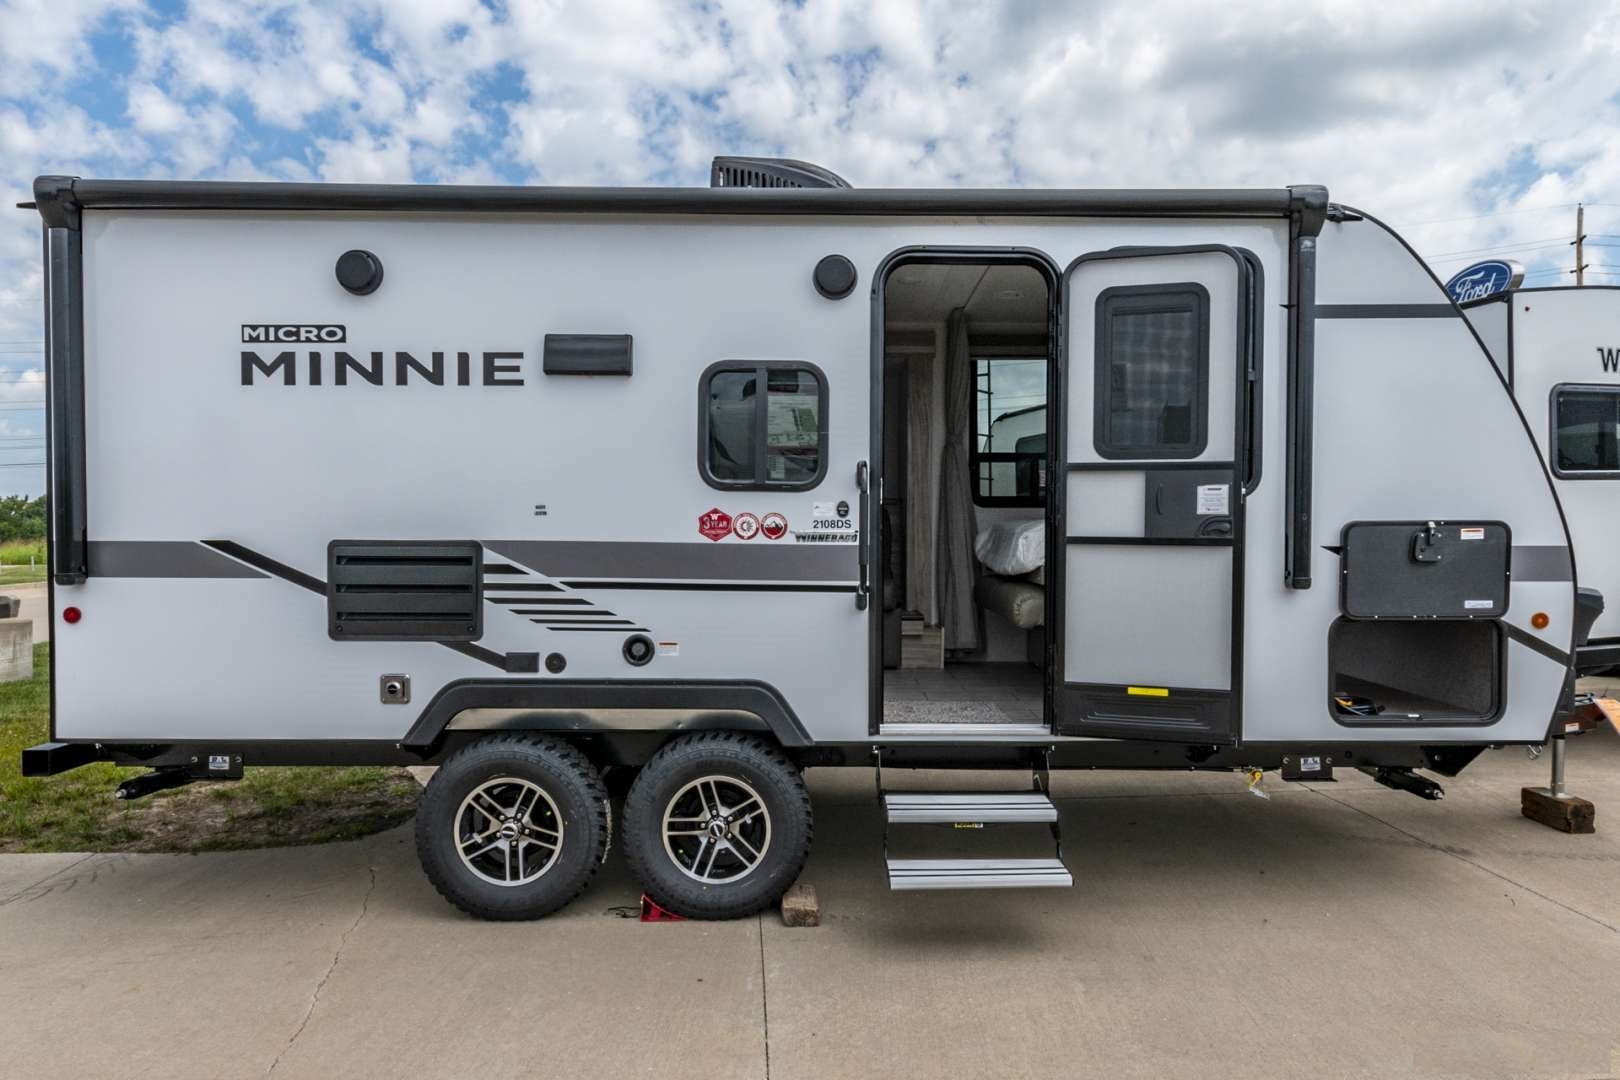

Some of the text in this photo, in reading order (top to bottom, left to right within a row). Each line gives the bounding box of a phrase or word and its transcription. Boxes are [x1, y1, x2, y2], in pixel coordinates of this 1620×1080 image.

[1454, 271, 1496, 303] Ford
[242, 326, 344, 341] MICRO
[241, 351, 524, 386] MINNIE
[703, 517, 710, 530] 3
[711, 520, 729, 528] YEAR
[813, 519, 852, 529] 2108DS
